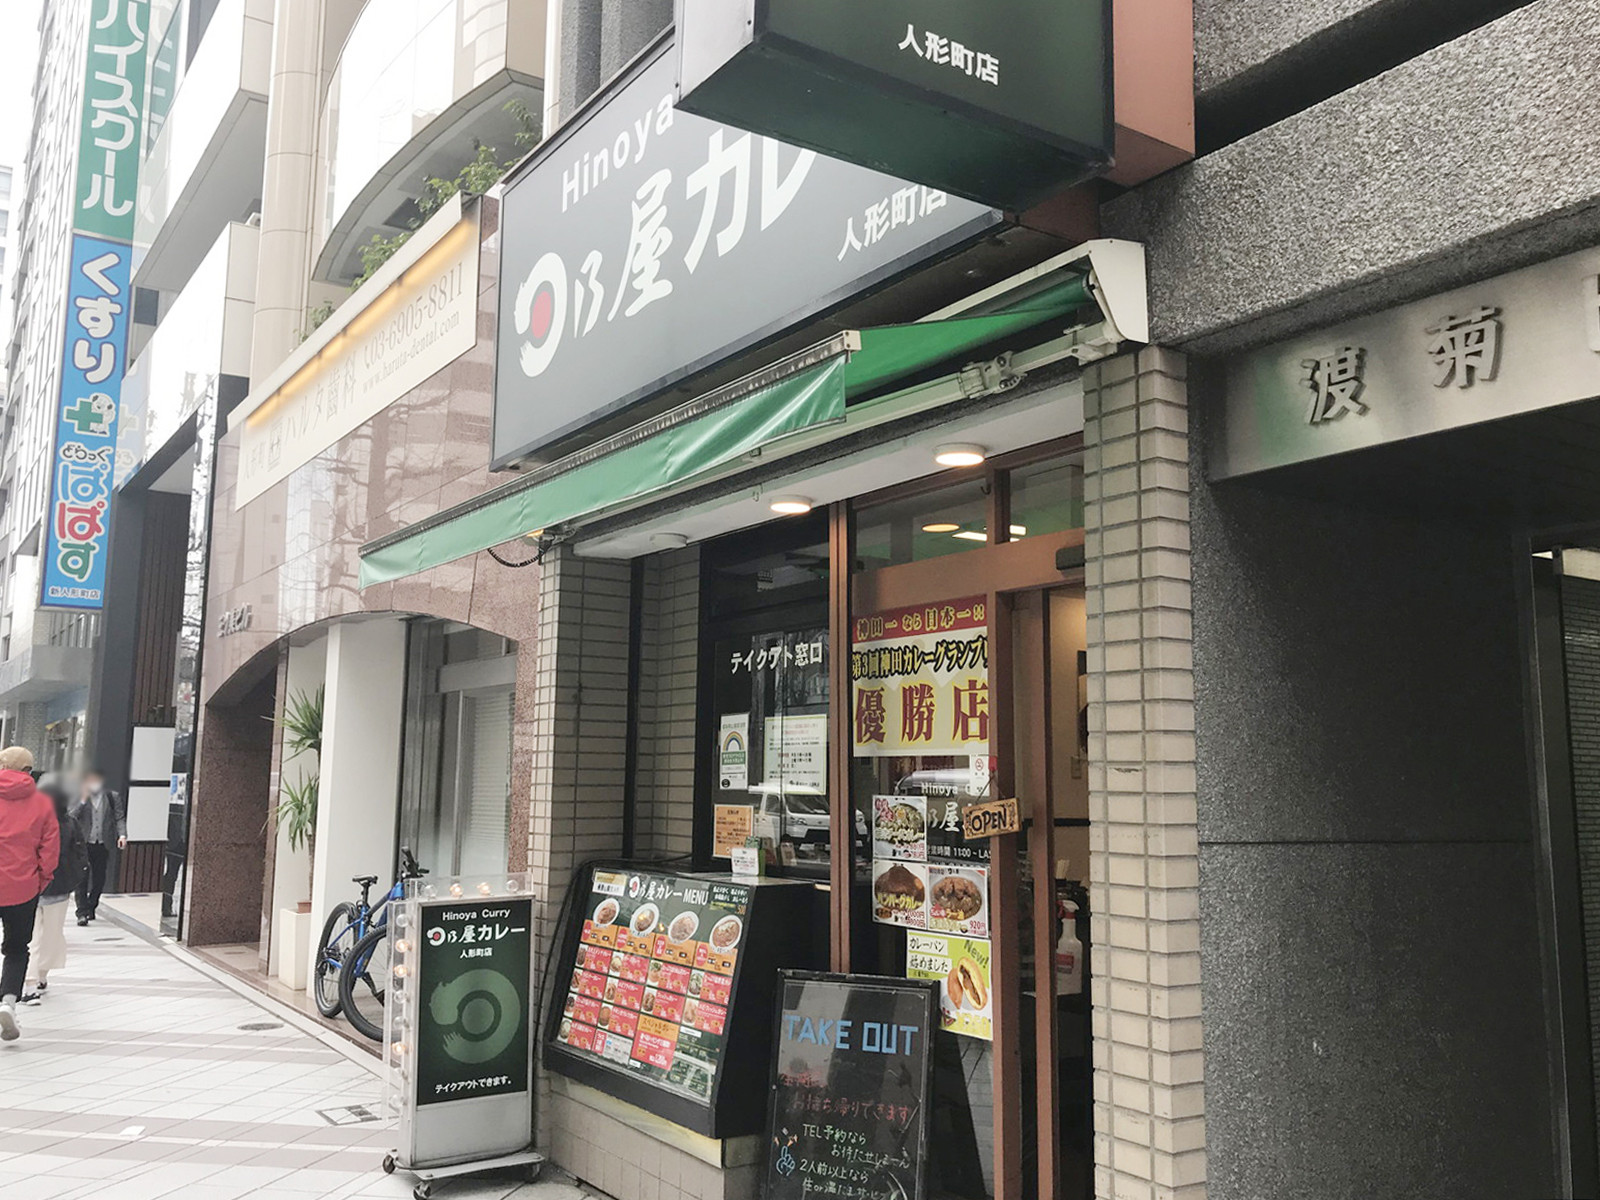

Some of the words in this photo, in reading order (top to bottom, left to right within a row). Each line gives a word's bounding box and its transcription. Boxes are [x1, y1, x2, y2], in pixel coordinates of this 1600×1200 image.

[898, 23, 1000, 86] 人形町店
[561, 93, 674, 213] Hinoya
[72, 251, 123, 384] くすり
[370, 262, 463, 366] 03-6905-8811
[61, 443, 113, 465] どらっぐ
[58, 463, 109, 581] ぱぱす
[856, 679, 989, 743] 優勝店
[971, 806, 1007, 834] OPEN
[441, 910, 477, 922] Hinoya
[481, 907, 511, 919] Curry
[909, 937, 945, 953] カレーパン
[964, 939, 990, 969] New!
[782, 1014, 852, 1050] TAKE
[862, 1021, 919, 1056] OUT
[799, 1158, 871, 1184] 2人前以上なら
